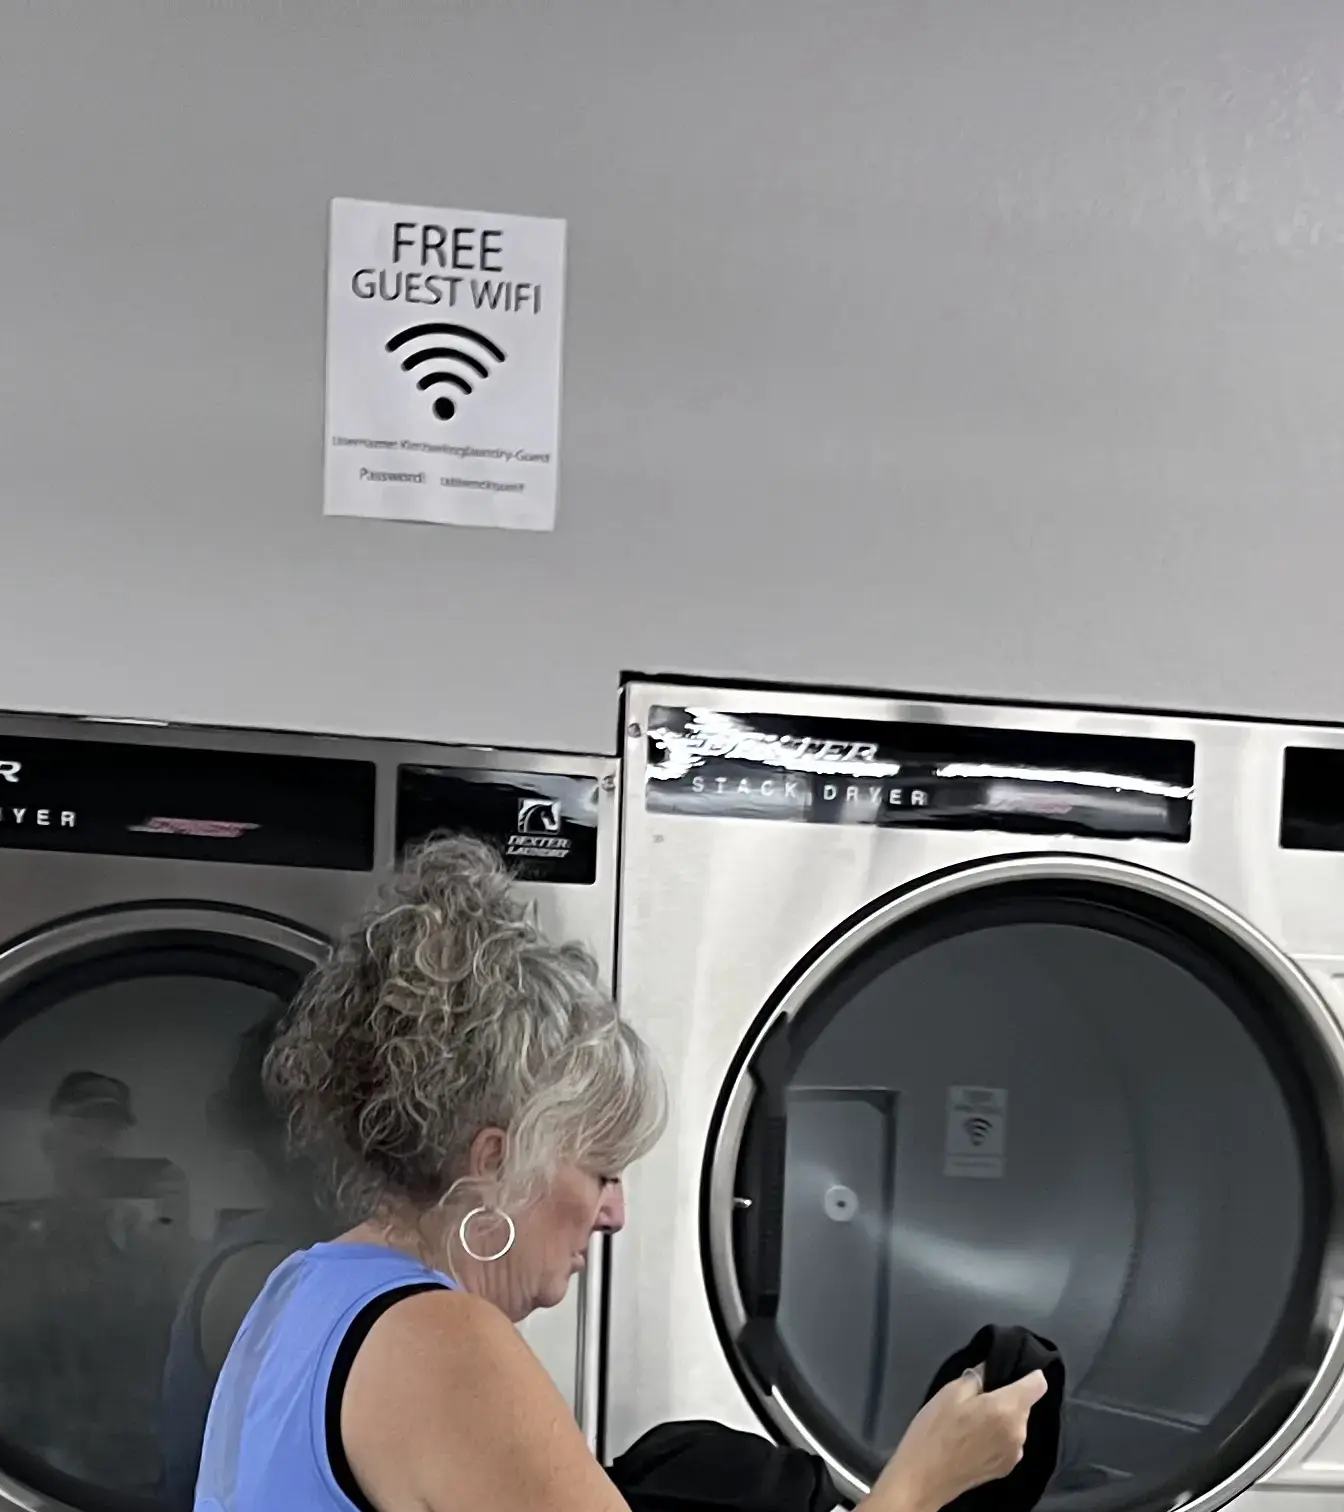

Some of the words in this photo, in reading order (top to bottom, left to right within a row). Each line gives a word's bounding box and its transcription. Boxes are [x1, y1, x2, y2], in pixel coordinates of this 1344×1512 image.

[392, 222, 503, 272] FREE
[351, 268, 463, 307] GUEST
[470, 279, 542, 314] WIFI
[691, 776, 801, 800] STACK
[823, 784, 929, 806] DRYER
[507, 835, 569, 848] DEXTER
